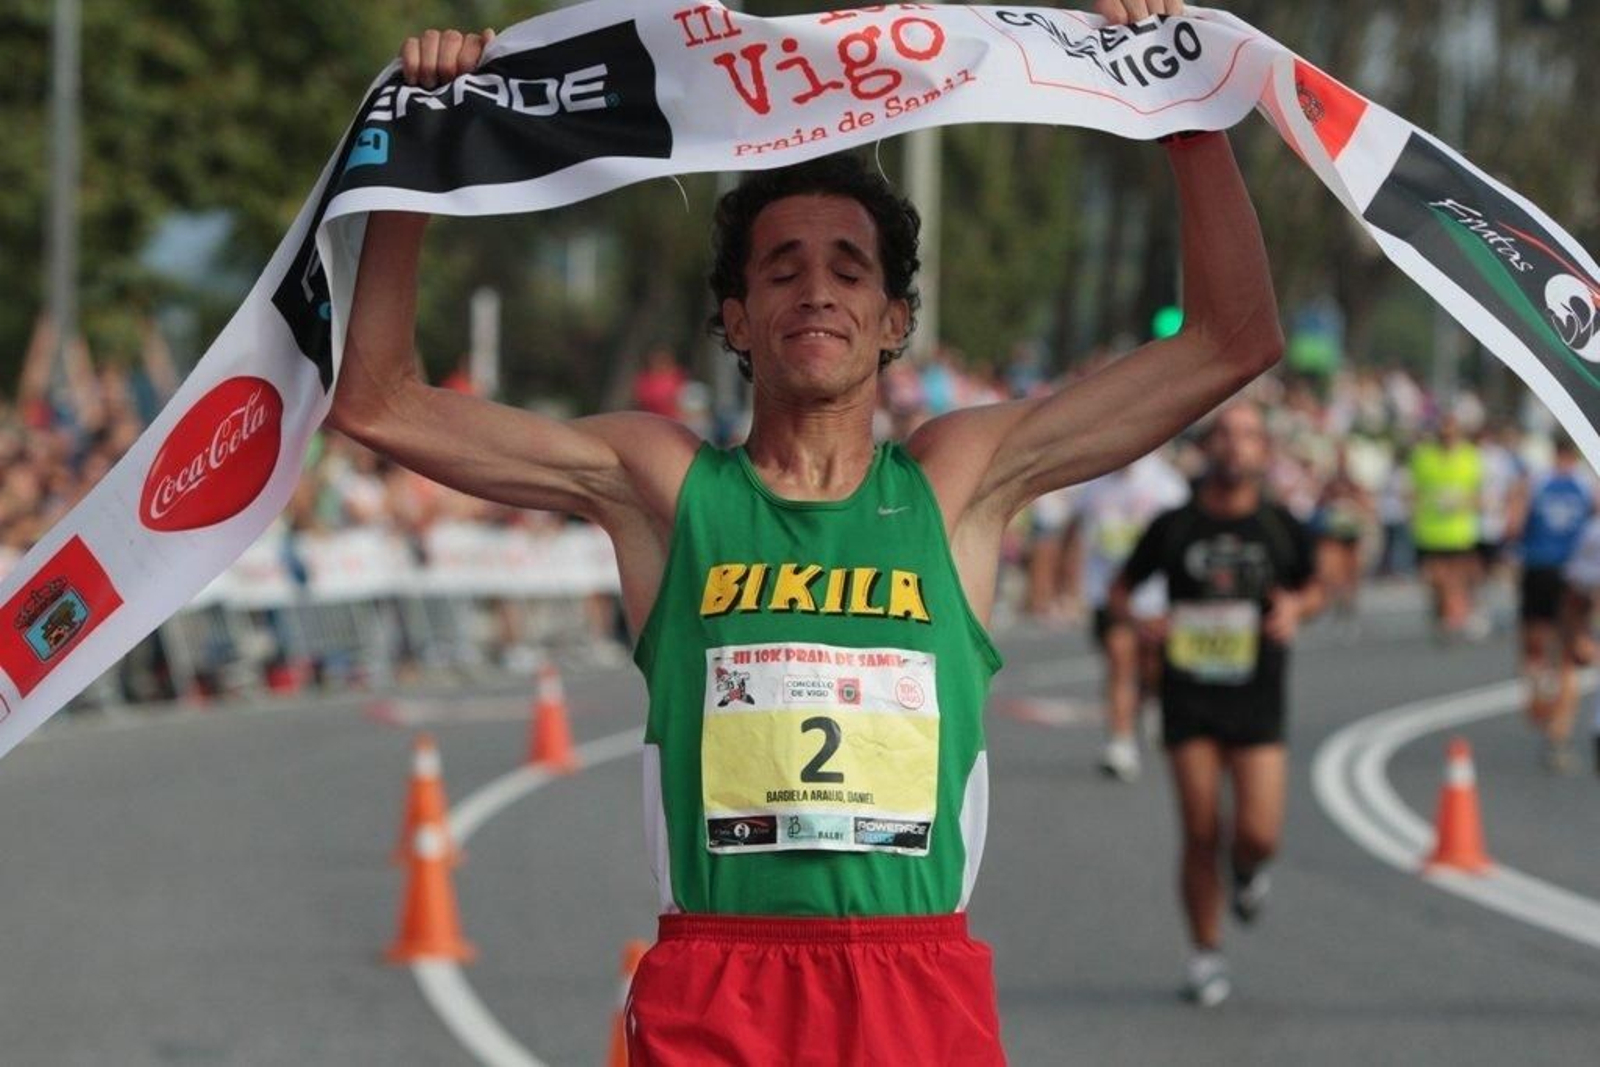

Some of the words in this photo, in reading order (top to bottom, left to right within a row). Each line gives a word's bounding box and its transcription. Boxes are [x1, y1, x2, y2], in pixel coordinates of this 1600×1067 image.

[674, 6, 741, 46] III
[713, 17, 945, 114] Vigo
[735, 127, 828, 157] Praia
[838, 111, 875, 135] de
[885, 68, 977, 119] Samil
[700, 563, 931, 624] BIKILA
[755, 649, 780, 663] 10K
[785, 648, 831, 664] PRAIA
[800, 716, 844, 783] 2
[766, 790, 808, 803] BARGIELA
